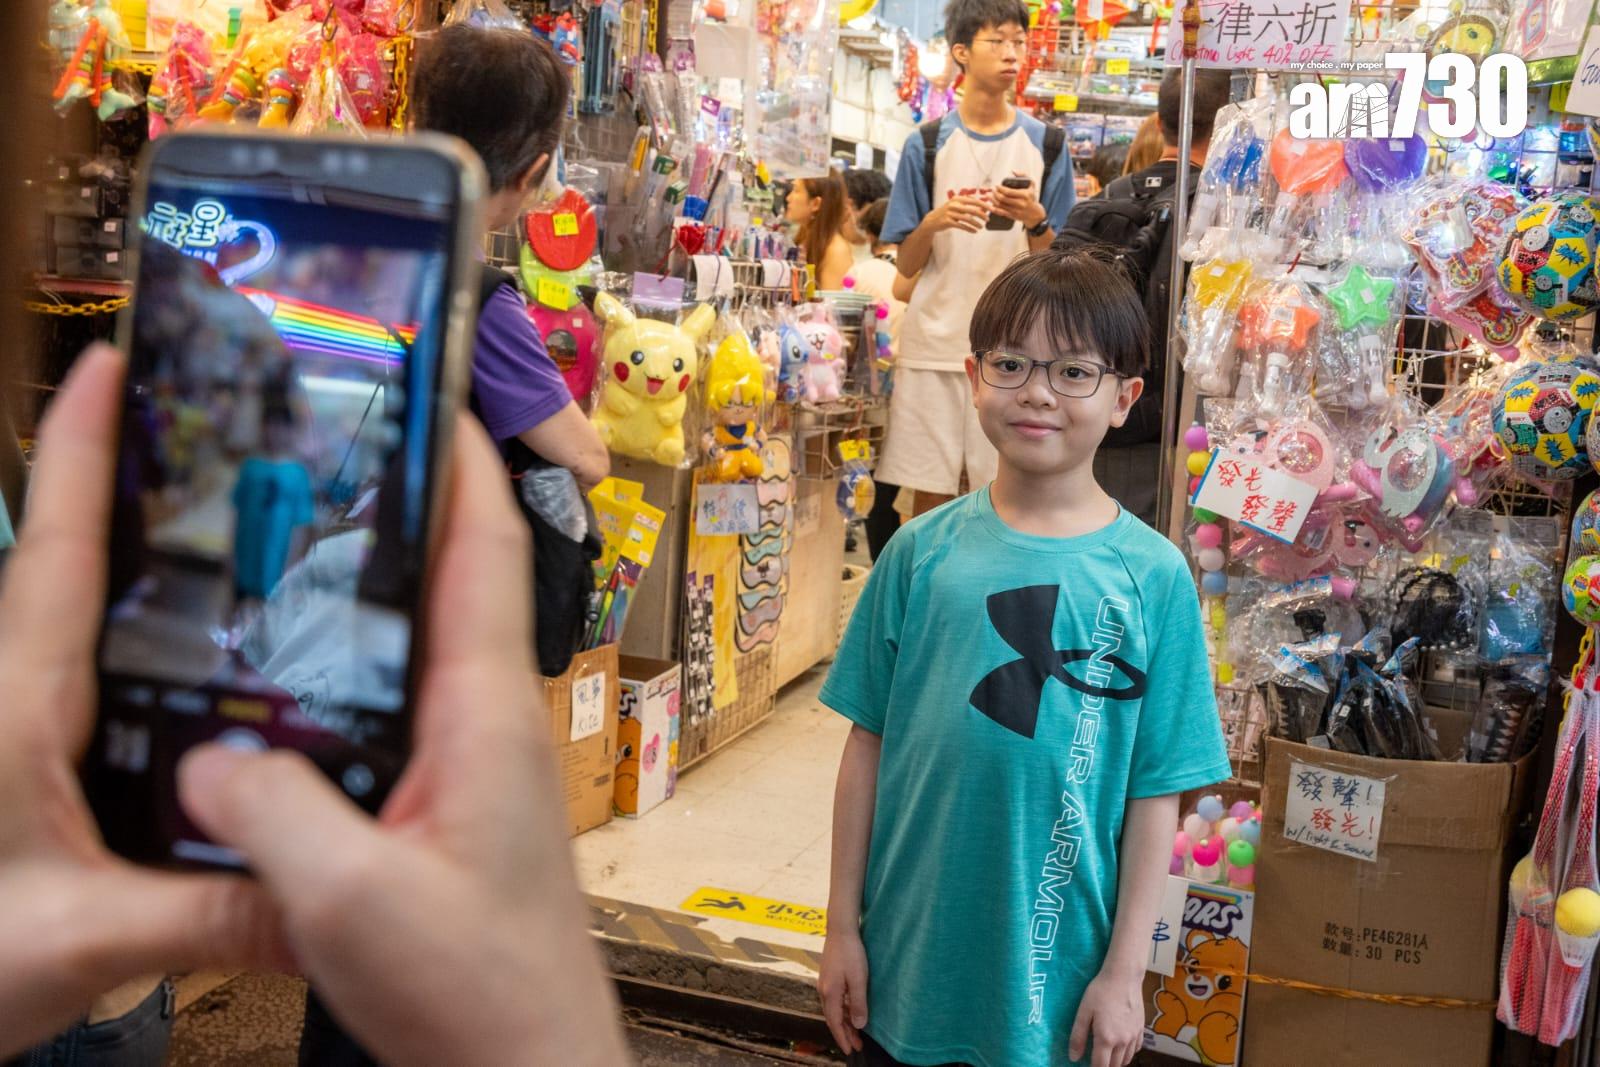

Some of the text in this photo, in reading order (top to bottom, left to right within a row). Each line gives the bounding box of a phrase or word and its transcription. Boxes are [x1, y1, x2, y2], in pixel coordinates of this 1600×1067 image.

[1263, 43, 1293, 64] 40%
[1066, 595, 1130, 785] UNDER
[1028, 790, 1084, 1025] ARMOUR
[1184, 898, 1240, 929] ARS
[1365, 945, 1382, 960] 30
[1394, 949, 1421, 965] PCS
